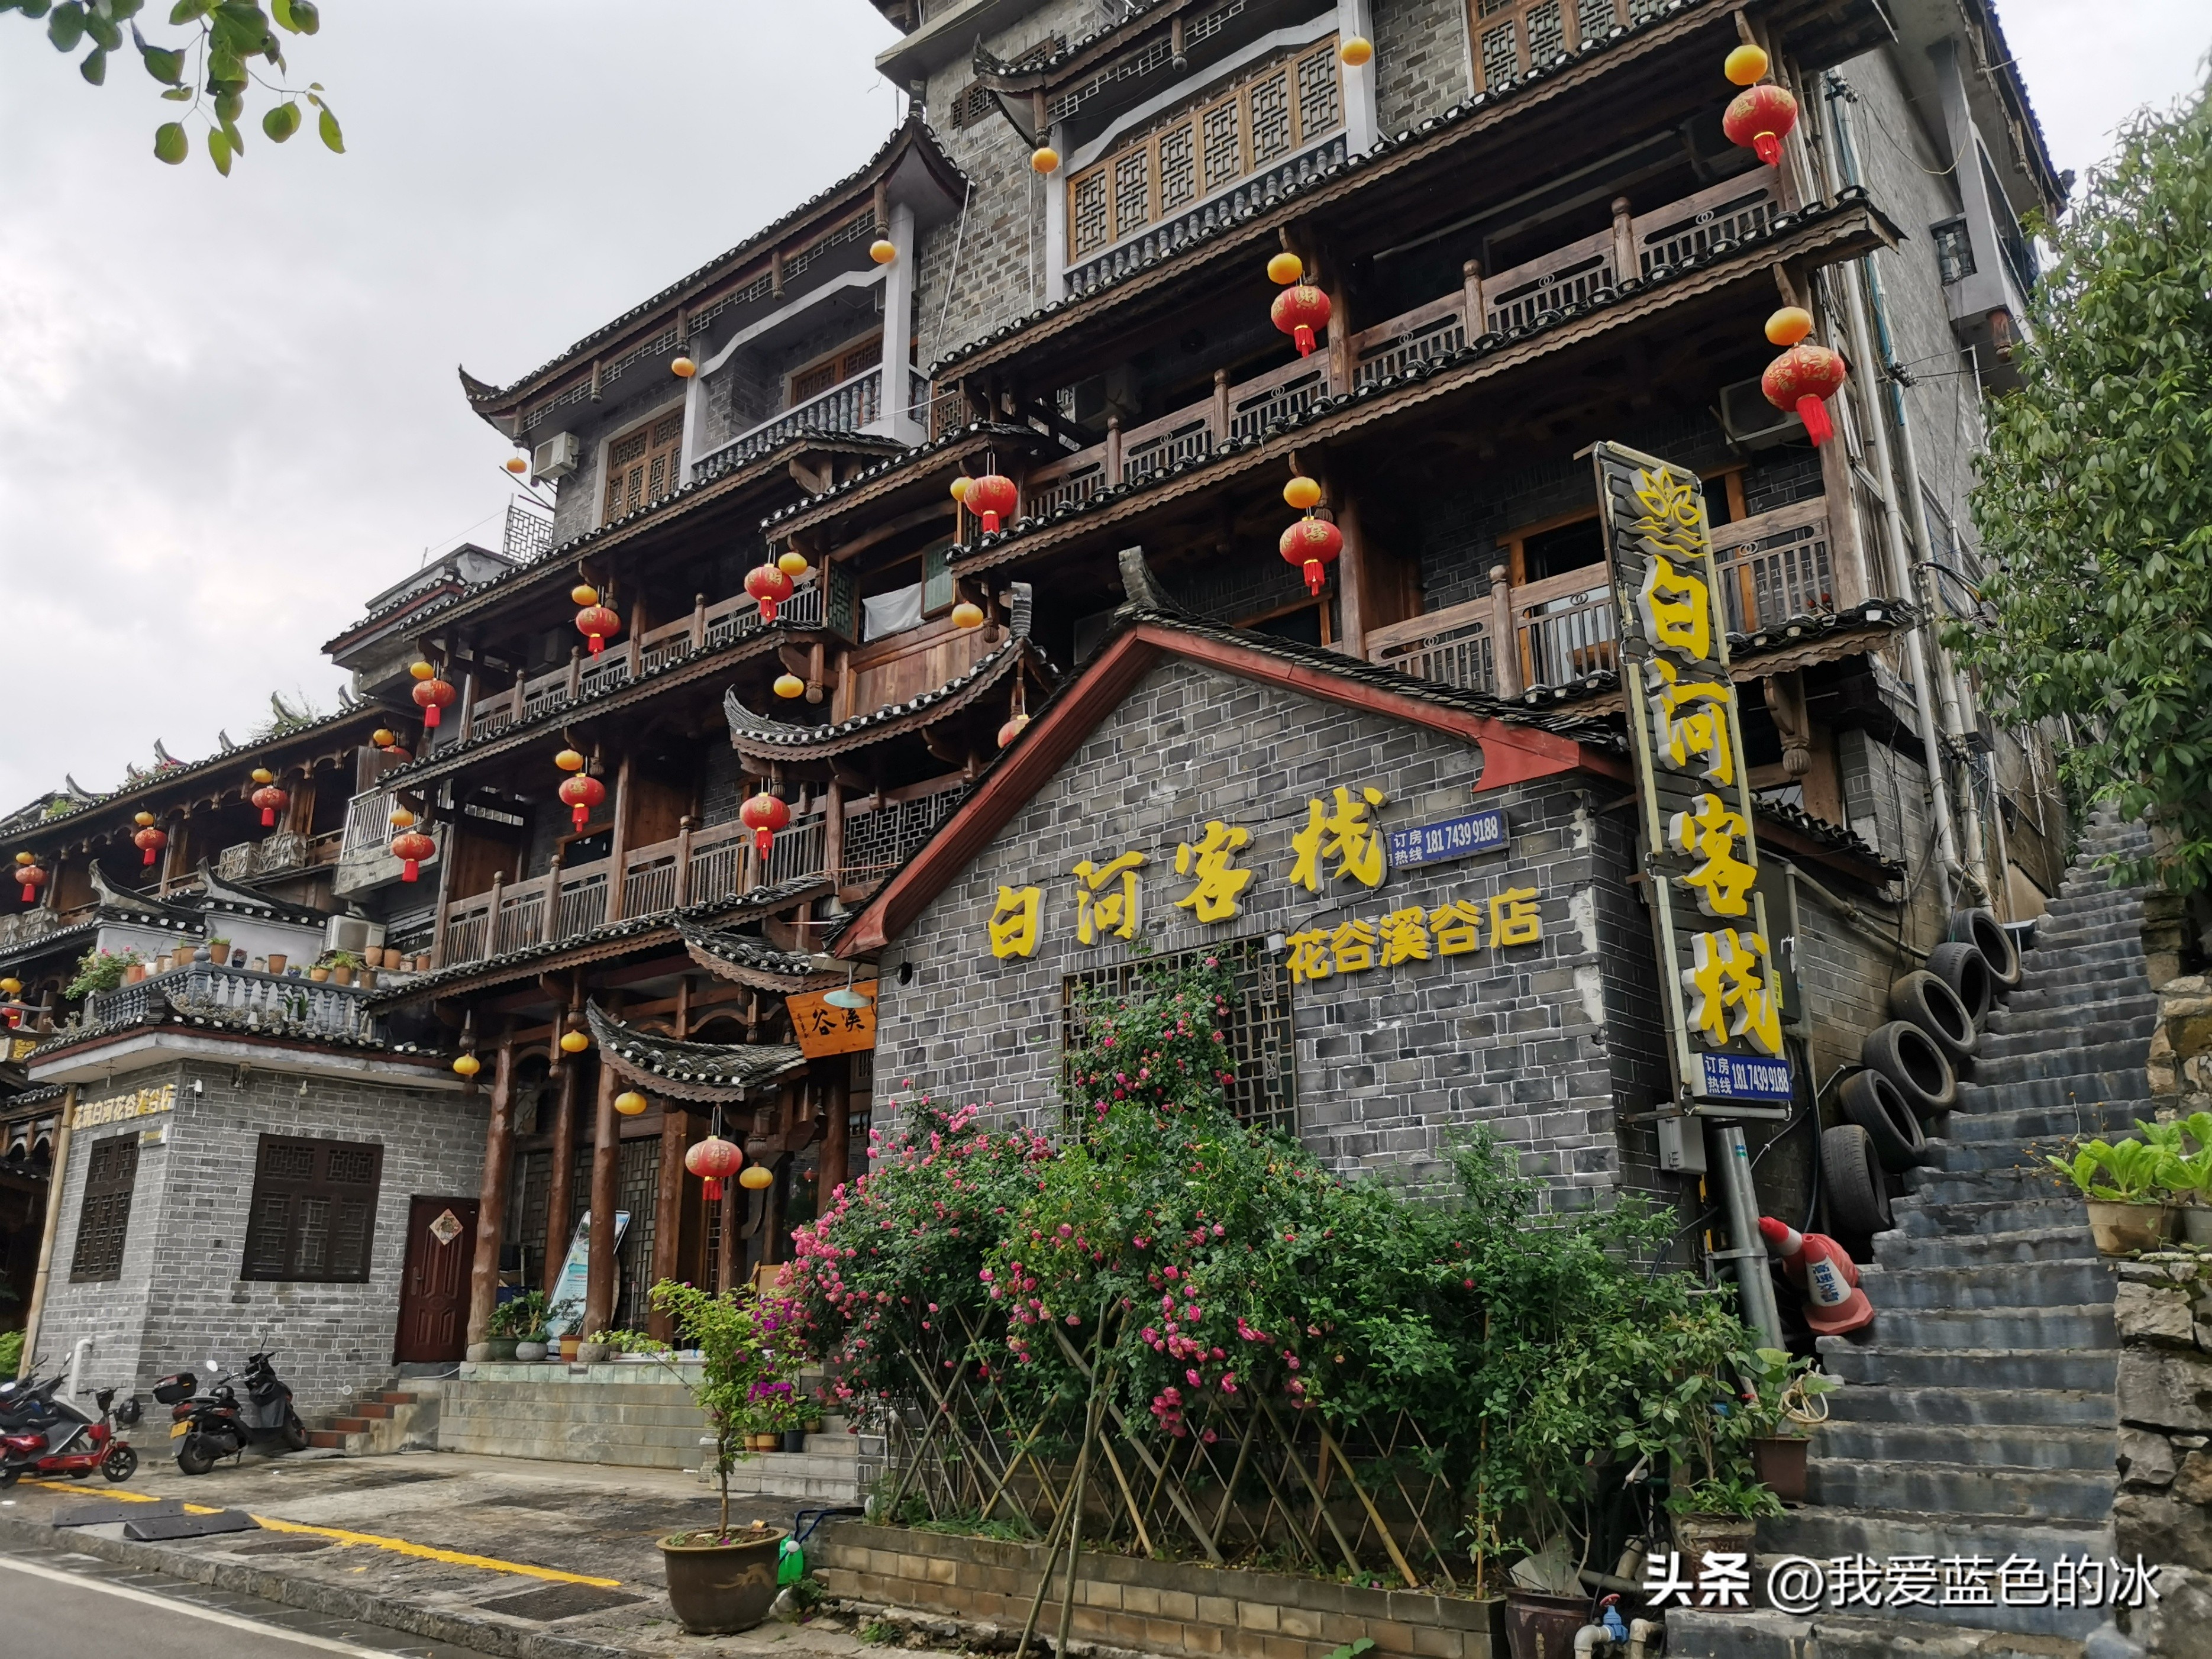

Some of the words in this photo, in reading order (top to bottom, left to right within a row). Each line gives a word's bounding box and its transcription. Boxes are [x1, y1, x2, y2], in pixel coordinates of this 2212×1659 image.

[1646, 554, 1780, 1053] 白河客栈
[1394, 830, 1422, 848] 订房
[1426, 829, 1444, 854] 181
[1445, 822, 1471, 850] 7439
[1472, 815, 1499, 844] 9188
[1394, 846, 1423, 866] 热线
[987, 787, 1388, 959] 白河客栈
[1286, 886, 1543, 983] 花谷溪谷店
[1705, 1056, 1729, 1075] 订房
[1732, 1063, 1748, 1090] 181
[1747, 1064, 1768, 1092] 7439
[1768, 1066, 1790, 1093] 9188
[1707, 1076, 1732, 1095] 热线
